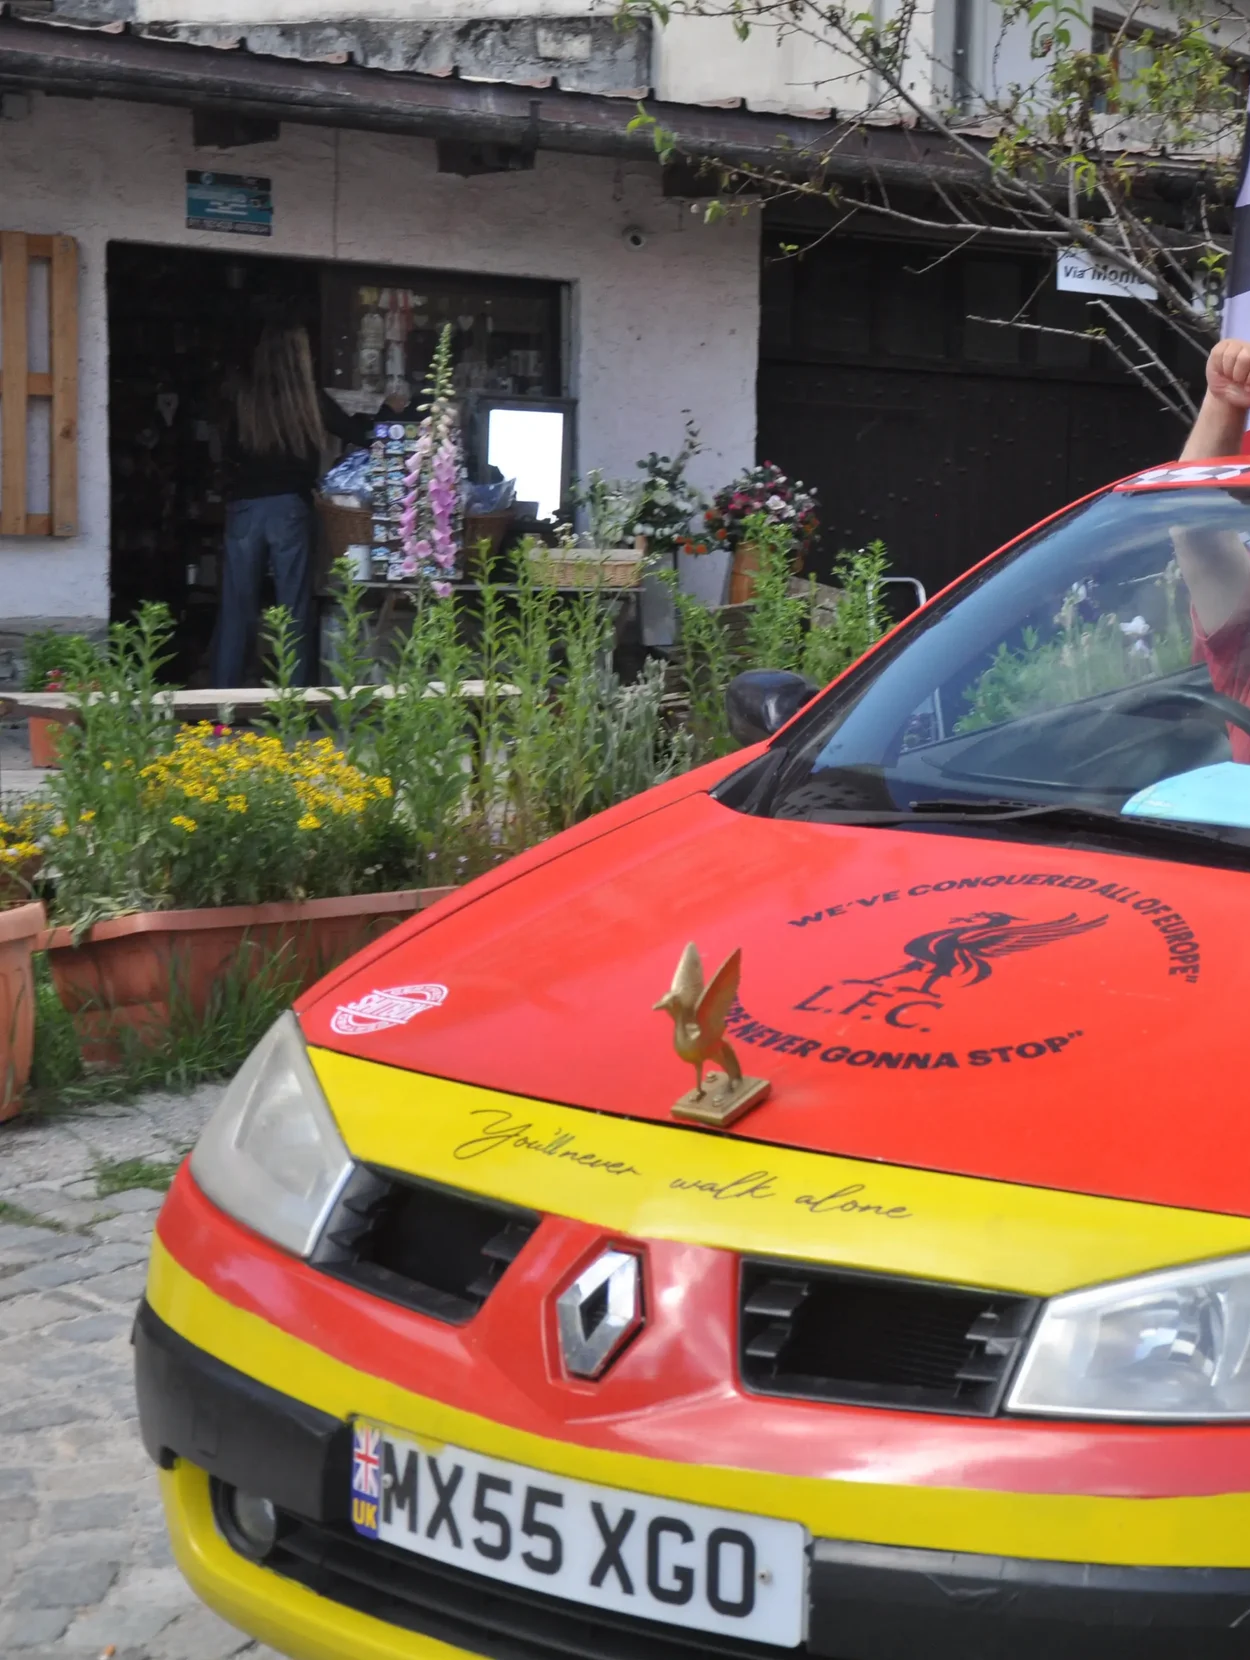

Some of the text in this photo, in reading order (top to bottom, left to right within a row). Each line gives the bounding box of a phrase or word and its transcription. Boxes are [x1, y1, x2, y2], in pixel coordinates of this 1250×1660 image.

[1063, 265, 1085, 279] Via
[788, 889, 900, 928] WE'VE
[906, 873, 1099, 898] CONQUERED
[1088, 882, 1141, 904] ALL
[1131, 898, 1173, 916] OF
[728, 1020, 822, 1058] NEVER
[819, 1045, 960, 1070] GONNA
[557, 1150, 642, 1177] never
[669, 1171, 777, 1200] walk
[795, 1184, 913, 1220] alone
[351, 1497, 378, 1530] UK
[381, 1440, 756, 1620] MX55 XGO
